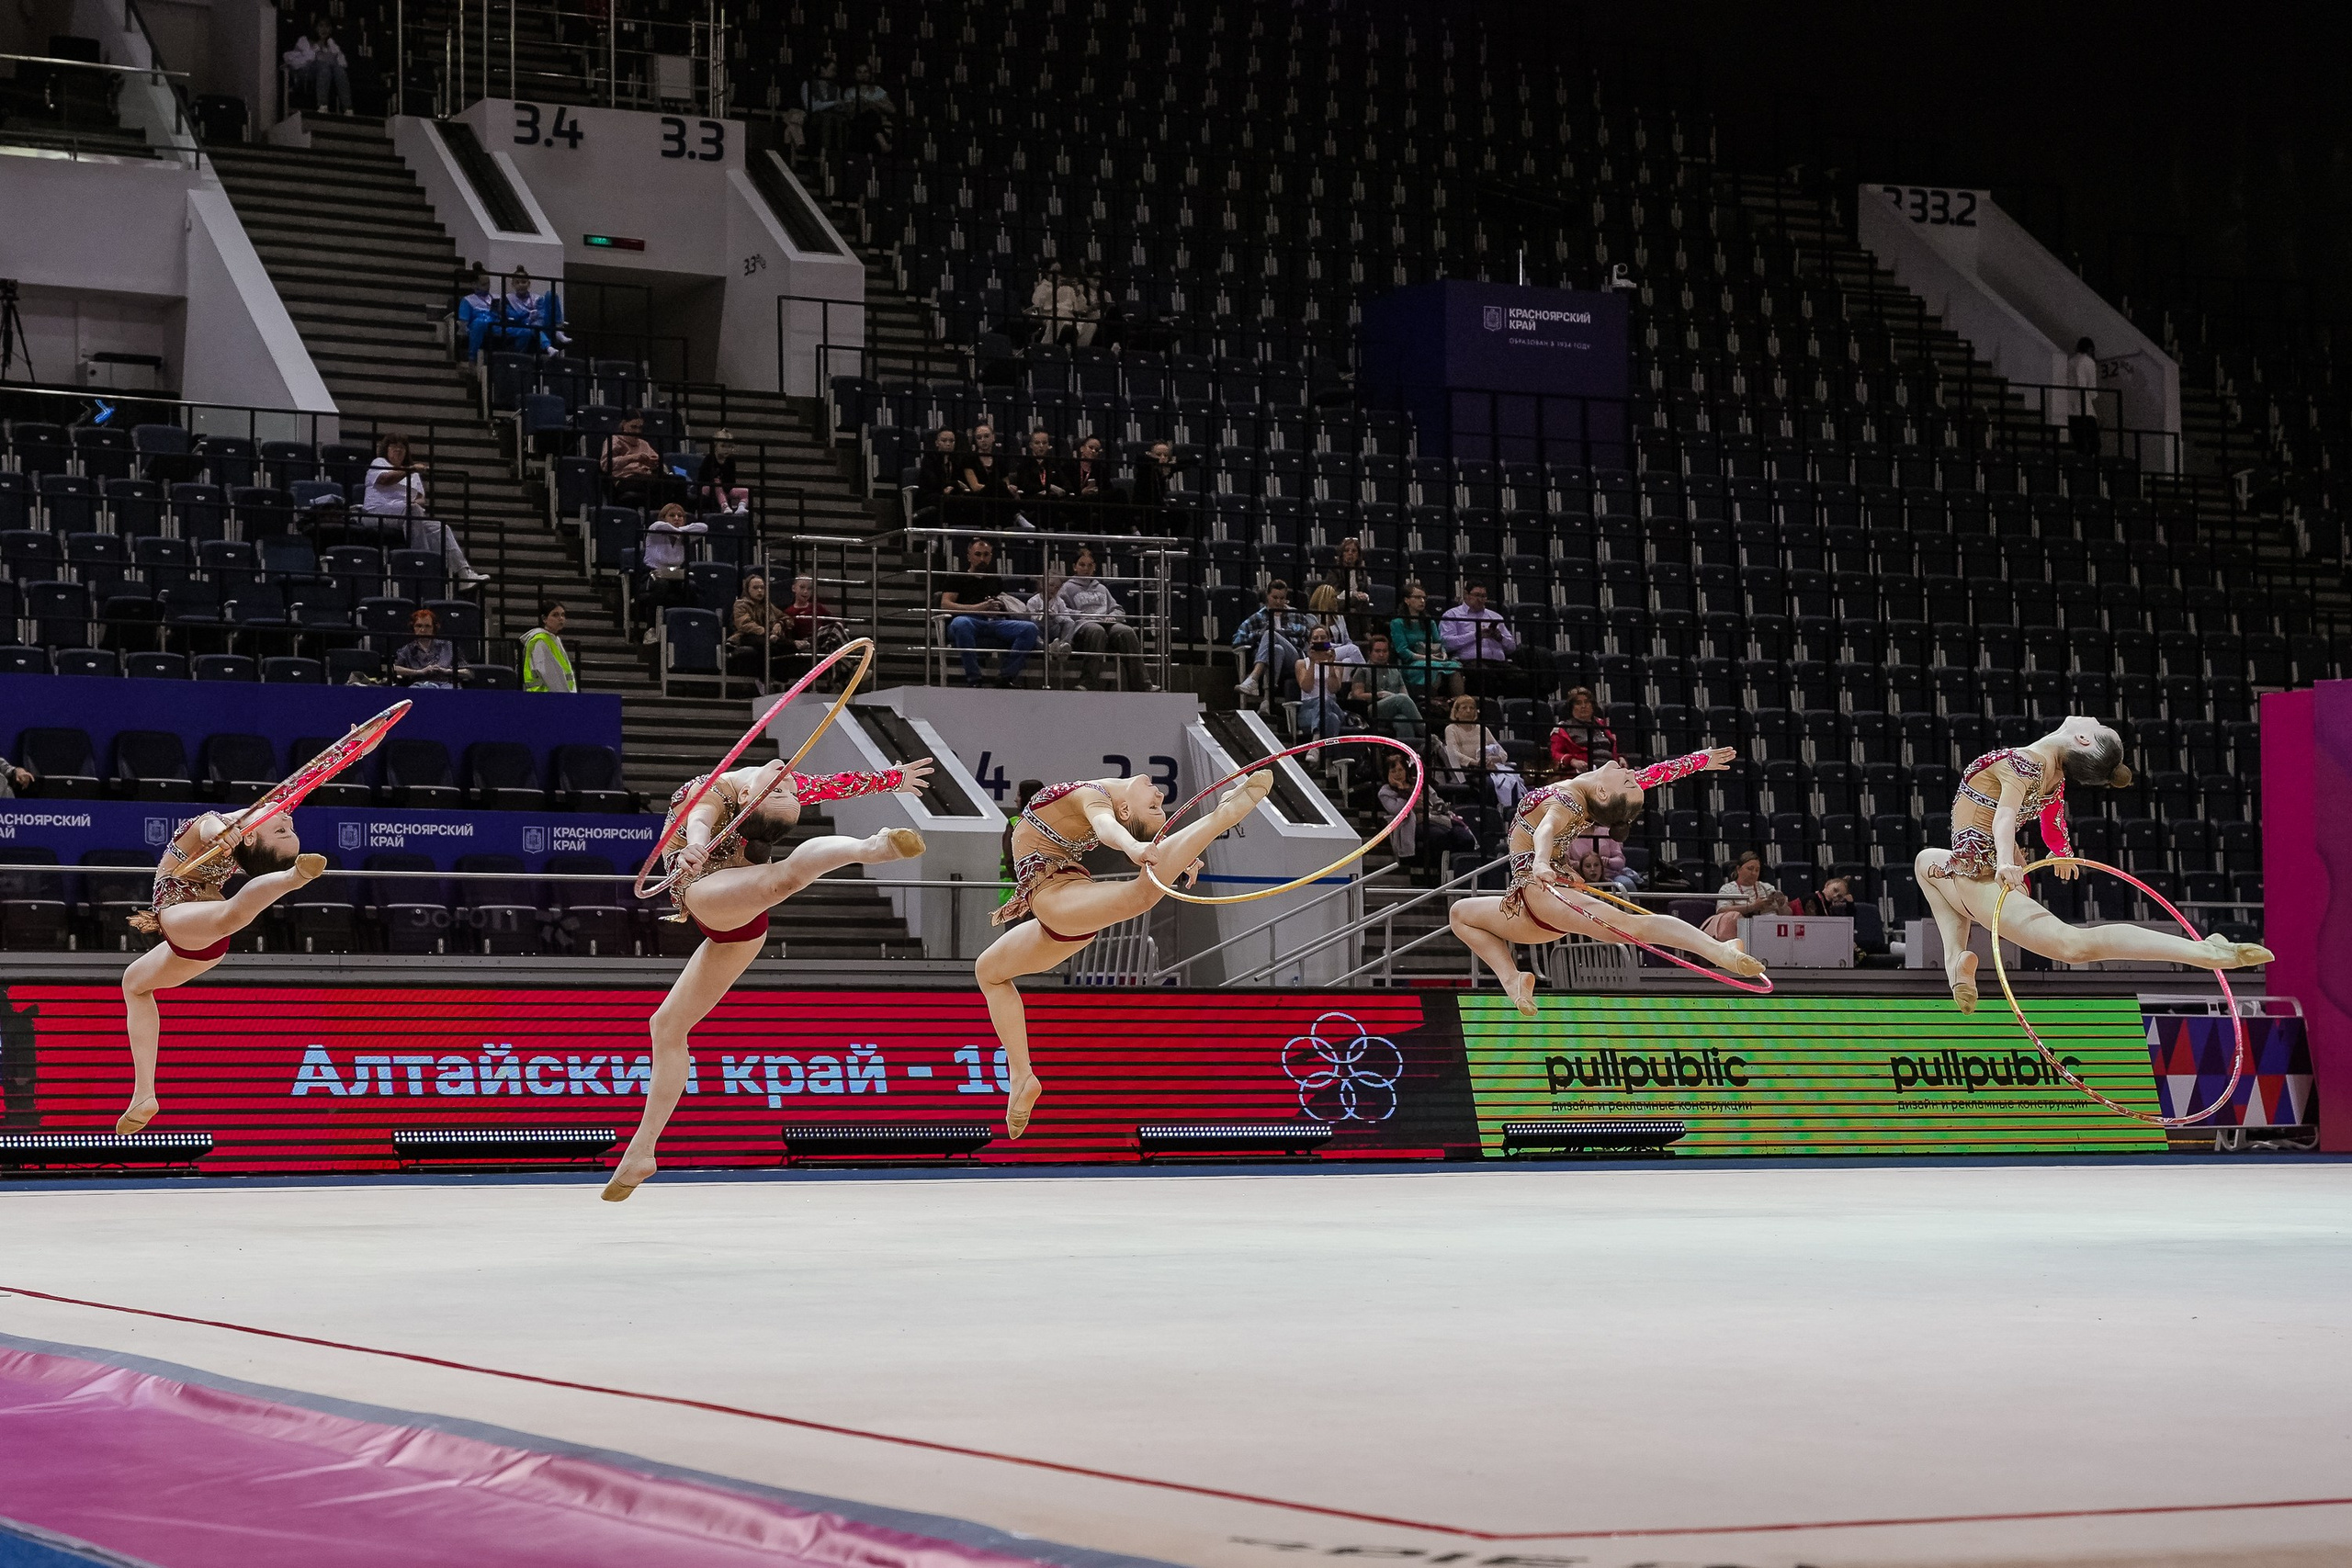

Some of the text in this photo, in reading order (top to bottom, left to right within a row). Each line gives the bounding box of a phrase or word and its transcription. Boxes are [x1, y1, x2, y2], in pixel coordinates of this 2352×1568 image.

[514, 103, 583, 149] 3.4
[661, 117, 725, 162] 3.3
[1509, 308, 1591, 324] КРАСНОЯРСКИЙ
[1509, 319, 1536, 331] КРАЙ
[370, 822, 473, 836] КРАСНОЯРСКИЙ
[553, 827, 653, 840] КРАСНОЯРСКИЙ
[370, 834, 404, 847] КРАЙ
[553, 838, 586, 851] КРАЙ
[721, 1043, 888, 1108] край
[1544, 1046, 1749, 1095] pullpublic
[1552, 1100, 1594, 1112] дизайн
[1609, 1101, 1675, 1112] рекламные
[1679, 1101, 1753, 1112] конструкции
[1898, 1099, 1938, 1111] дизайн
[1951, 1100, 2014, 1111] рекламные
[2018, 1100, 2088, 1111] конструкции
